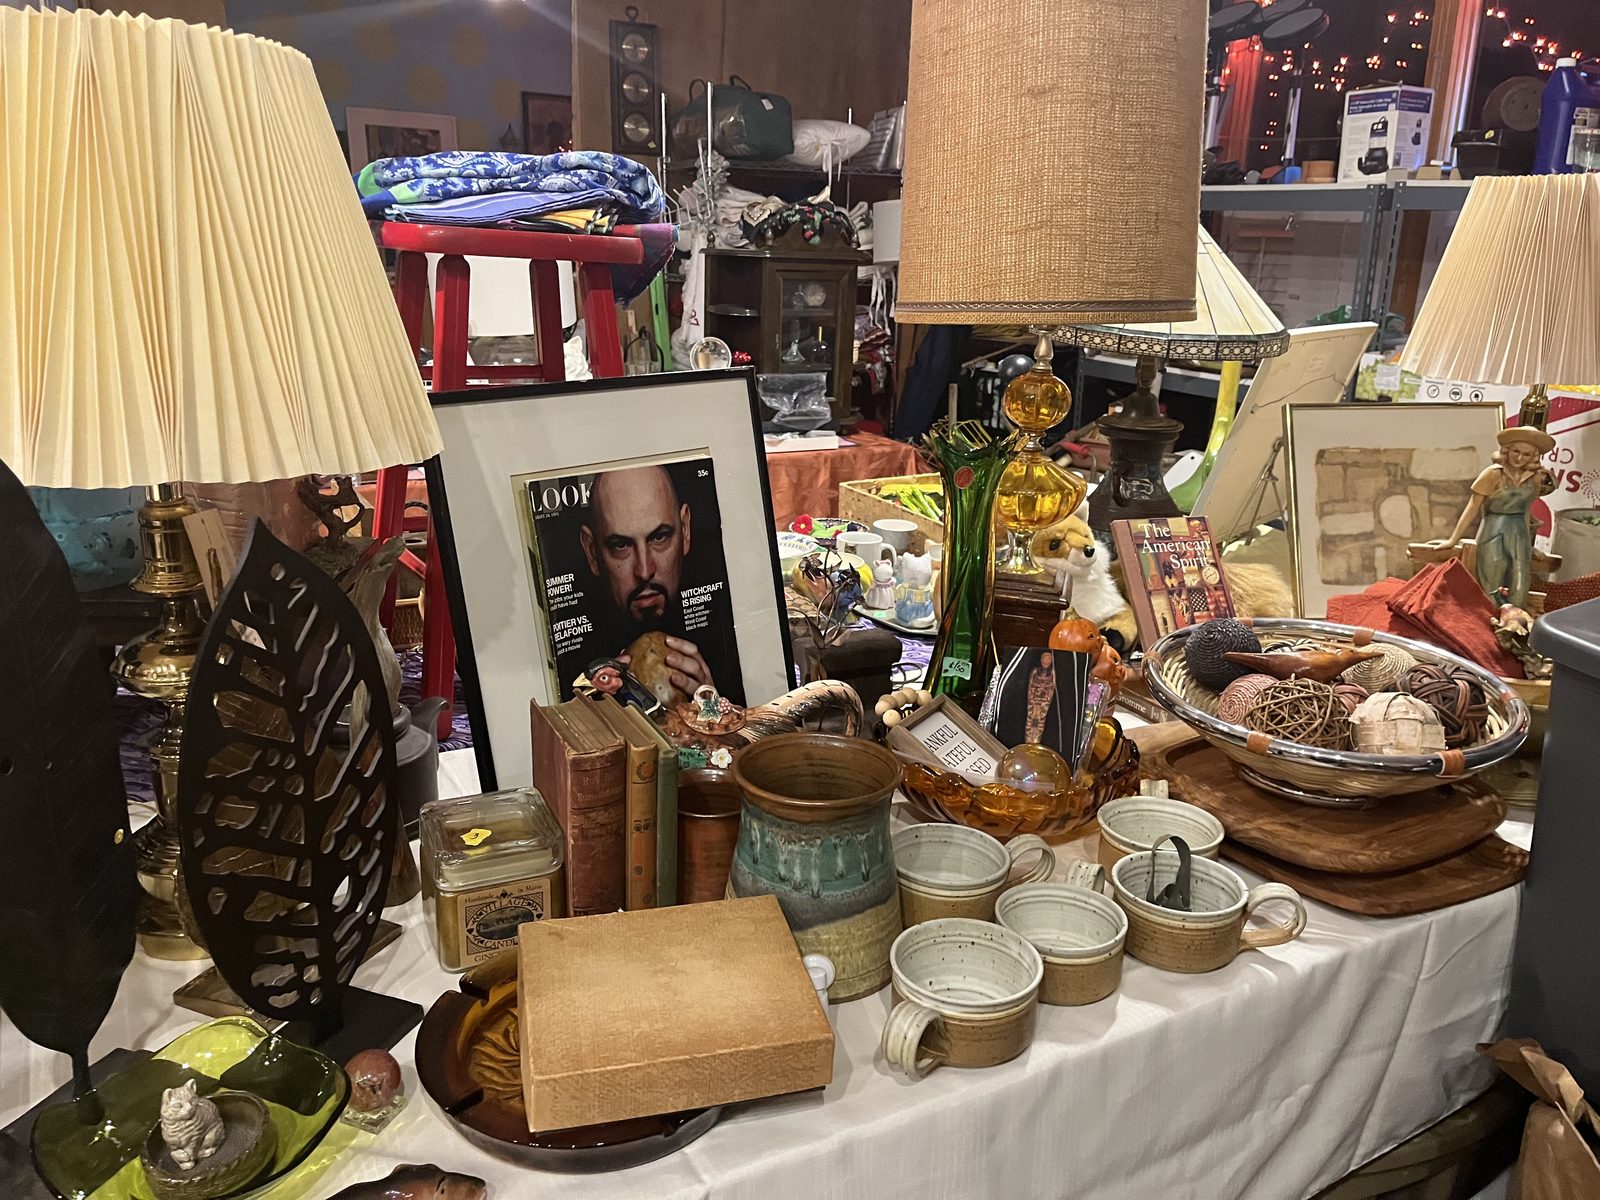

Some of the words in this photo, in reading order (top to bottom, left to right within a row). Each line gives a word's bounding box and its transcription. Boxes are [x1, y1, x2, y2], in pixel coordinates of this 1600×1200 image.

[531, 482, 594, 512] LOOK
[1138, 522, 1171, 539] The
[1141, 539, 1211, 554] American
[1169, 554, 1210, 570] Spirit
[546, 573, 574, 588] SUMMER
[547, 583, 573, 598] POWER!
[681, 582, 723, 598] WITCHCRAFT
[682, 599, 689, 607] IS
[690, 593, 712, 605] RISING
[576, 615, 590, 625] VS.
[554, 623, 594, 642] BELAFONTE
[923, 724, 959, 753] ANKFUL
[942, 741, 977, 768] ATEFUL
[482, 898, 528, 914] VILLAGE
[484, 937, 519, 949] CANDL
